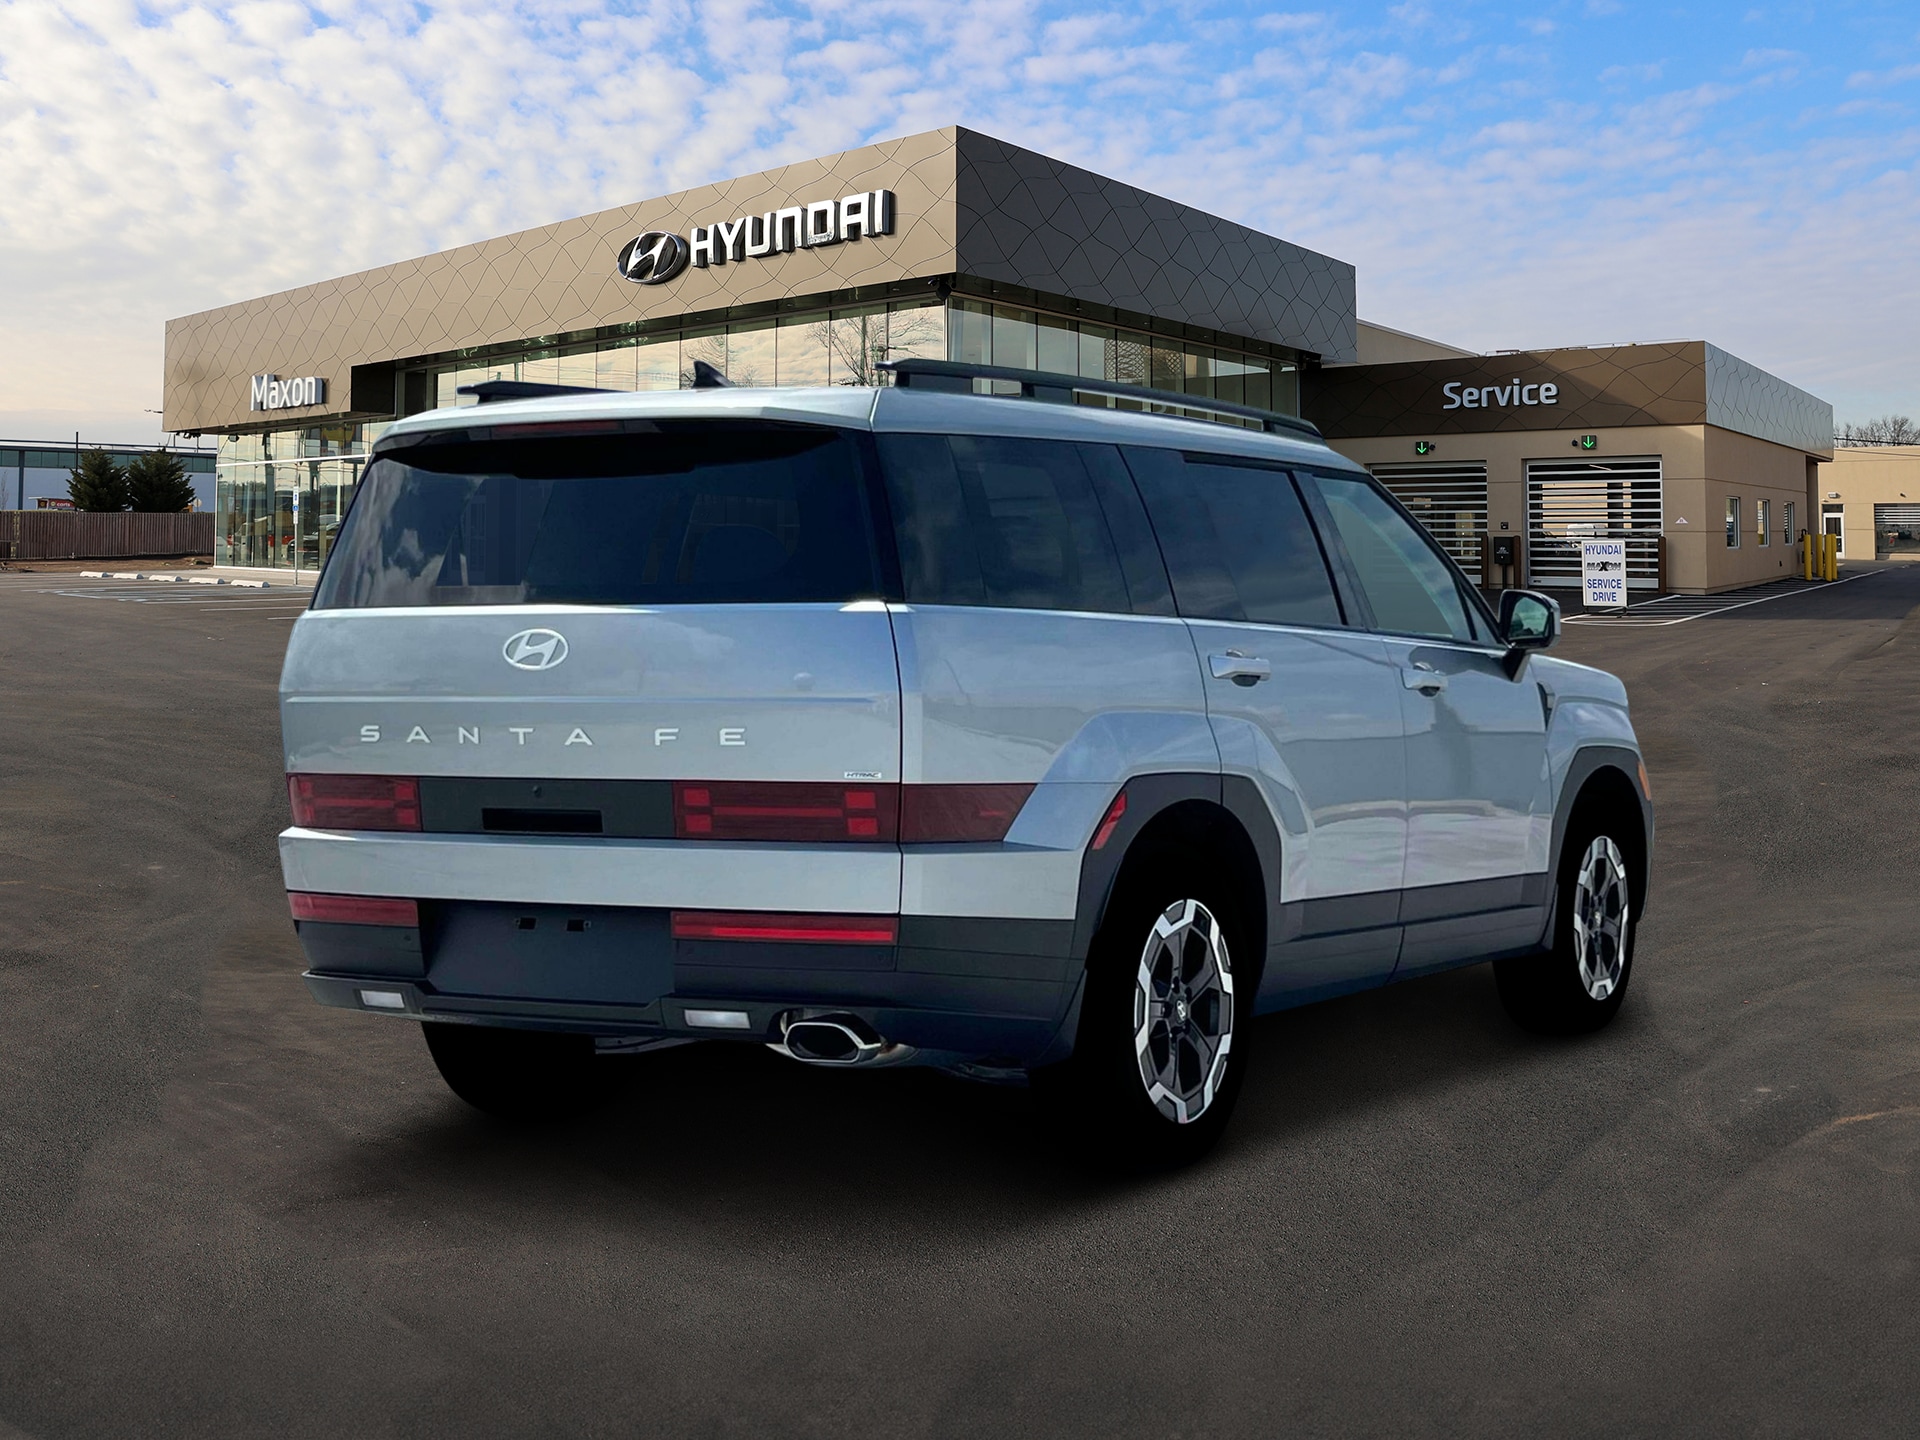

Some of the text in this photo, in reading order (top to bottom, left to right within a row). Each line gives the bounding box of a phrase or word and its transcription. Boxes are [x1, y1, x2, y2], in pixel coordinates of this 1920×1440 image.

[690, 189, 894, 268] HYUNDAI
[250, 374, 321, 411] Maxon
[1443, 378, 1558, 409] Service
[1585, 545, 1622, 555] HYUNDAI
[1586, 561, 1622, 571] MAXON
[1587, 578, 1622, 589] SERVICE
[1592, 591, 1617, 602] DRIVE
[360, 725, 746, 746] SANTA FE
[845, 771, 881, 779] HTRAC
